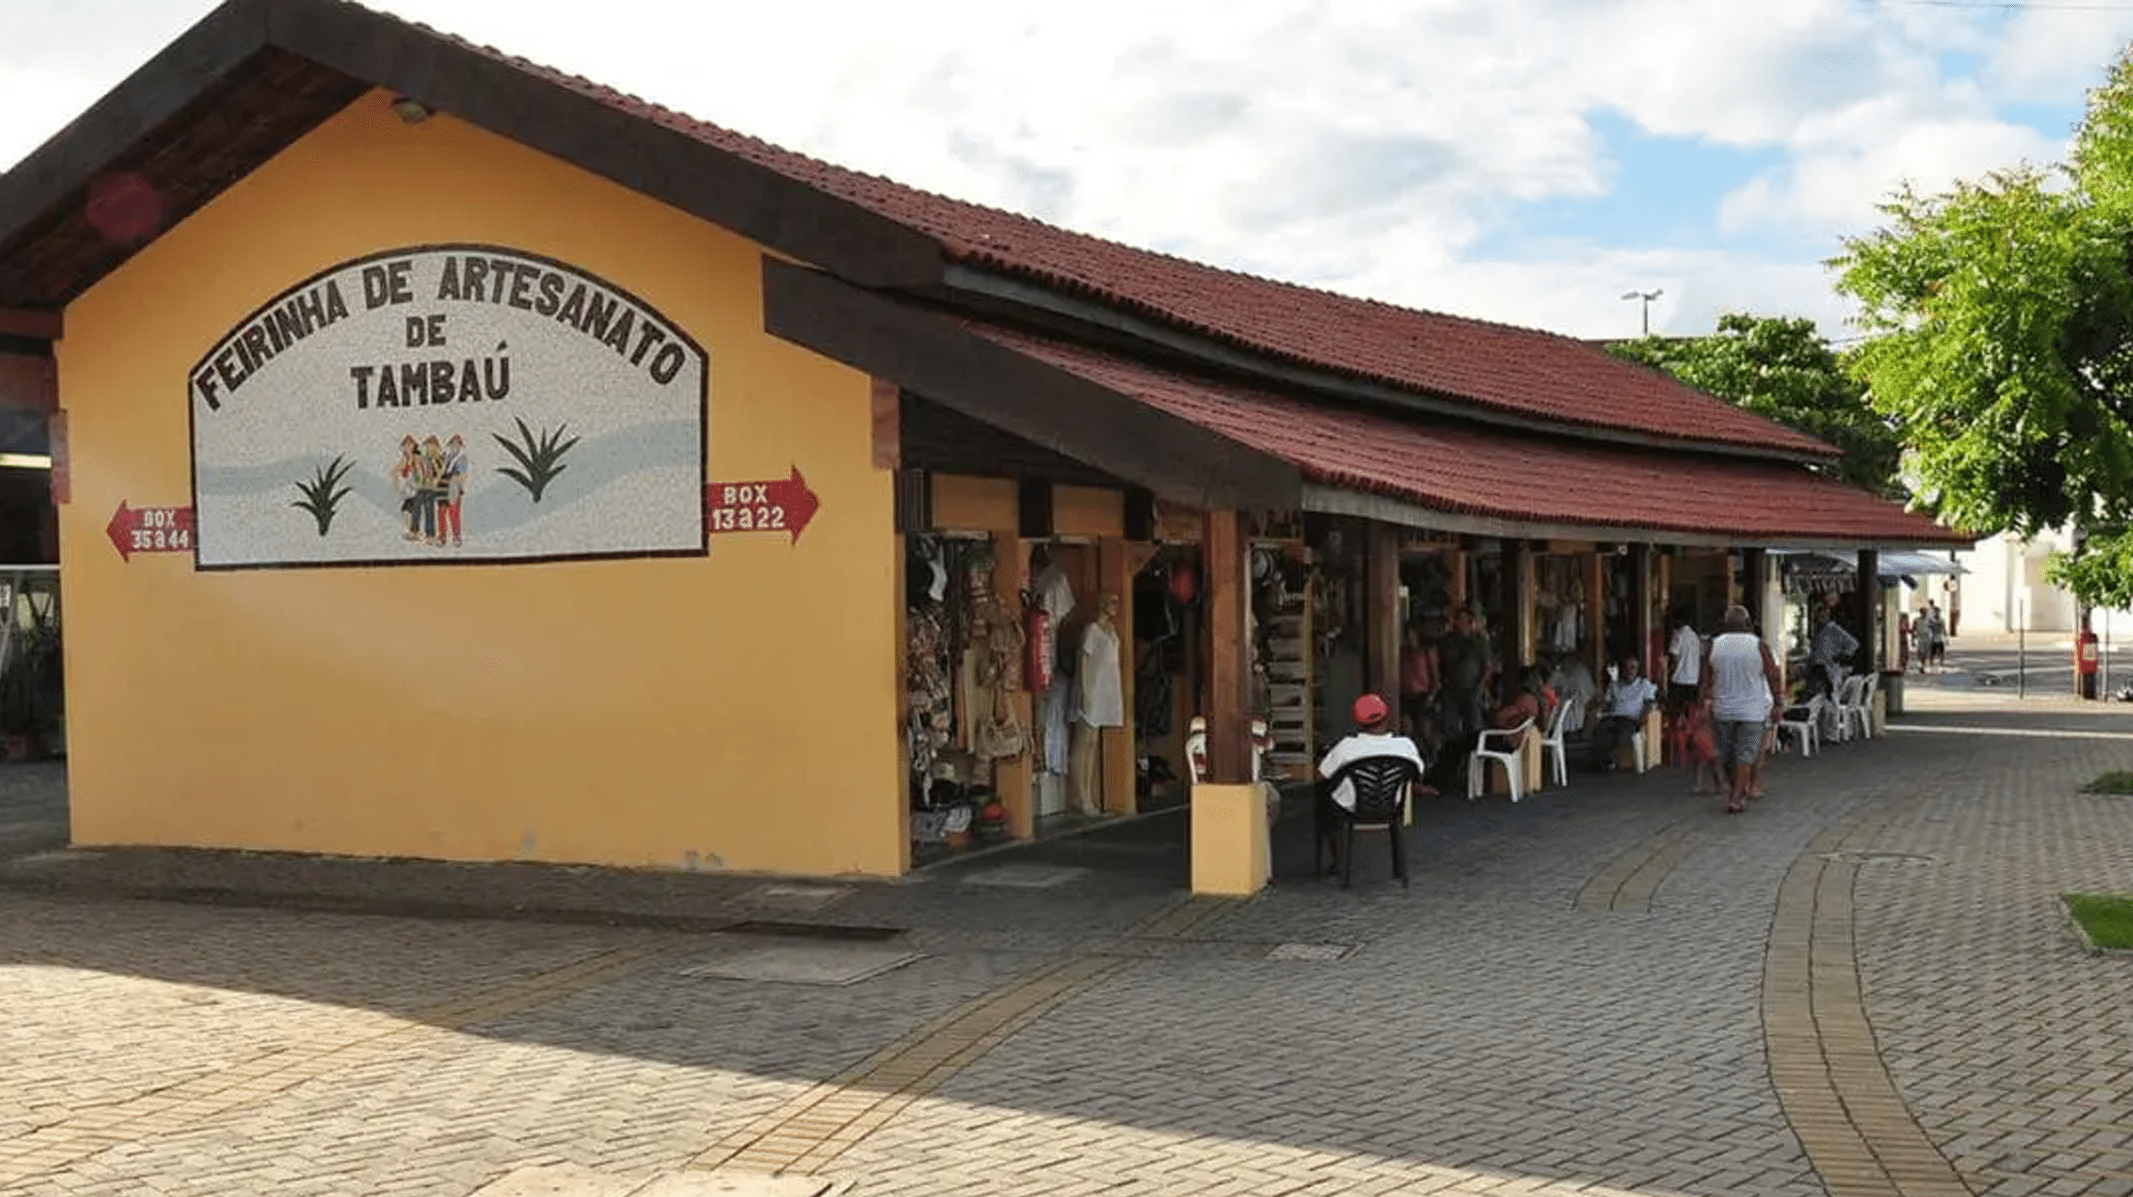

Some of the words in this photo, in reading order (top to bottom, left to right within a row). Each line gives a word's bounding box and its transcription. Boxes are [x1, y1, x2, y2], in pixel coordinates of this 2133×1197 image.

[195, 279, 349, 411] FEIRINHA
[362, 261, 413, 310] DE
[437, 256, 686, 385] ARTESANATO
[406, 314, 446, 348] DE
[350, 340, 509, 409] TAMBAÚ
[724, 485, 767, 504] BOX
[144, 510, 175, 528] BOX
[713, 508, 735, 530] 13
[757, 506, 785, 528] 22
[169, 530, 189, 548] 44
